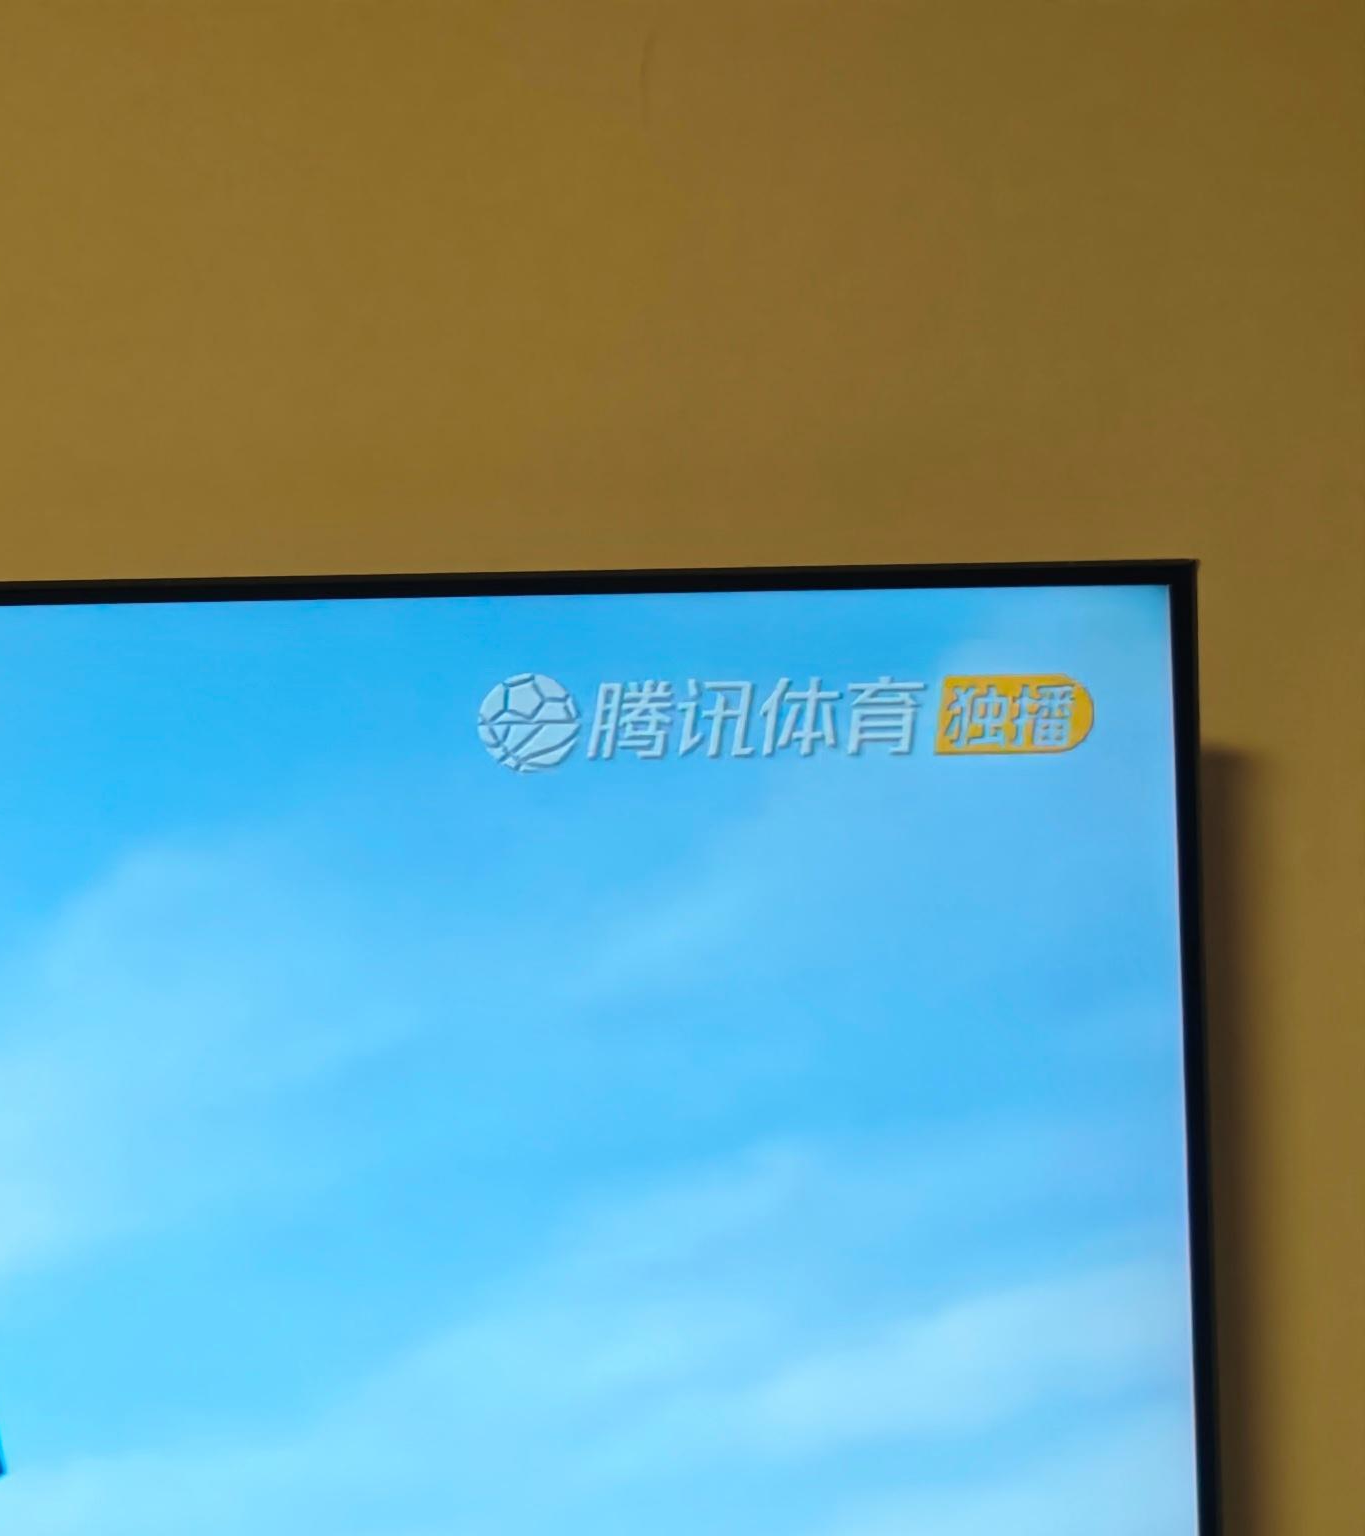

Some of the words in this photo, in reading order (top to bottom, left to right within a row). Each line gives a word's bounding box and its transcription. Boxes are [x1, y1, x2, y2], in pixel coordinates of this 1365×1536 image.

[586, 677, 926, 760] 腾讯体育
[943, 681, 1075, 750] 独播
